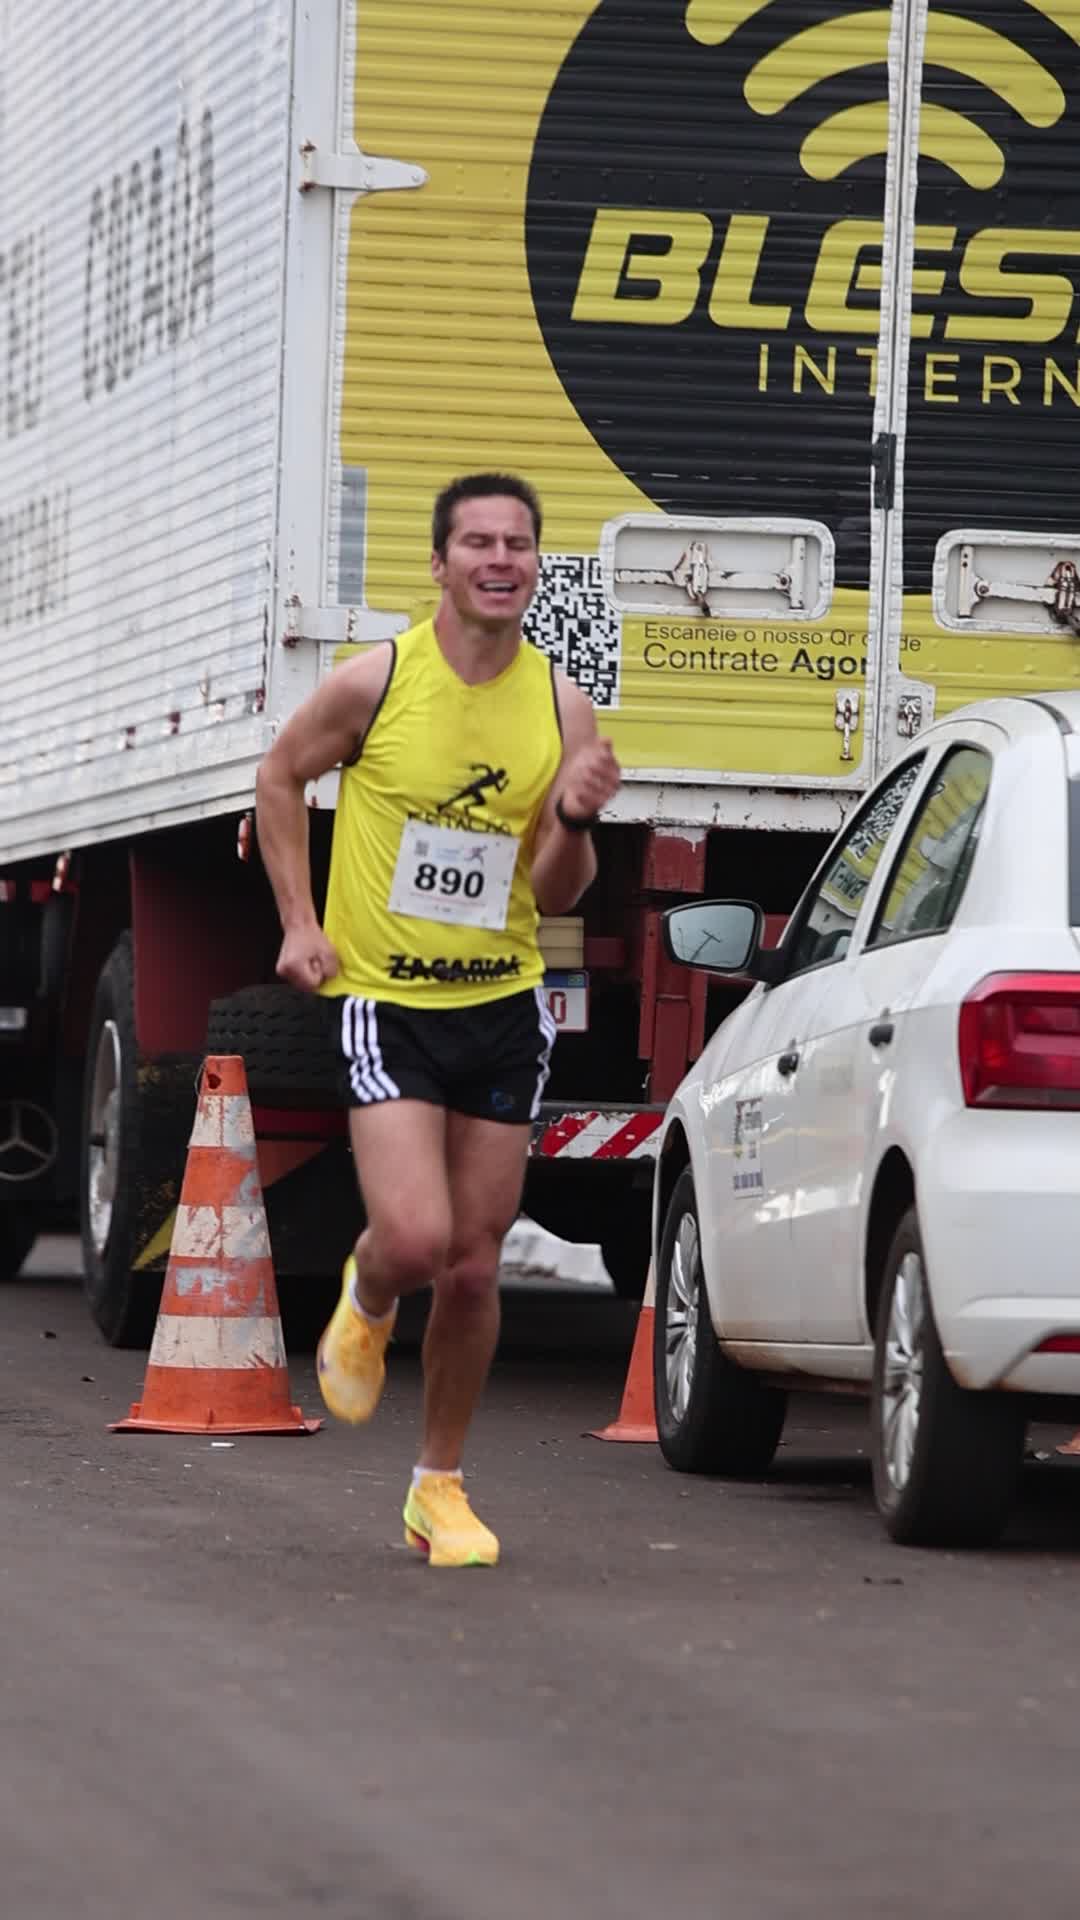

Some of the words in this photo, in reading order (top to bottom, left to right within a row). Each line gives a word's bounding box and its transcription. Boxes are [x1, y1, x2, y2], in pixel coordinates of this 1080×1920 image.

[570, 207, 1080, 343] BLES
[644, 622, 737, 642] Escaneie
[743, 629, 757, 642] o
[763, 629, 824, 645] nosso
[830, 628, 855, 648] Qr
[861, 634, 921, 652] cde
[643, 642, 779, 673] Contrate
[790, 648, 902, 681] Agor
[414, 862, 485, 899] 890
